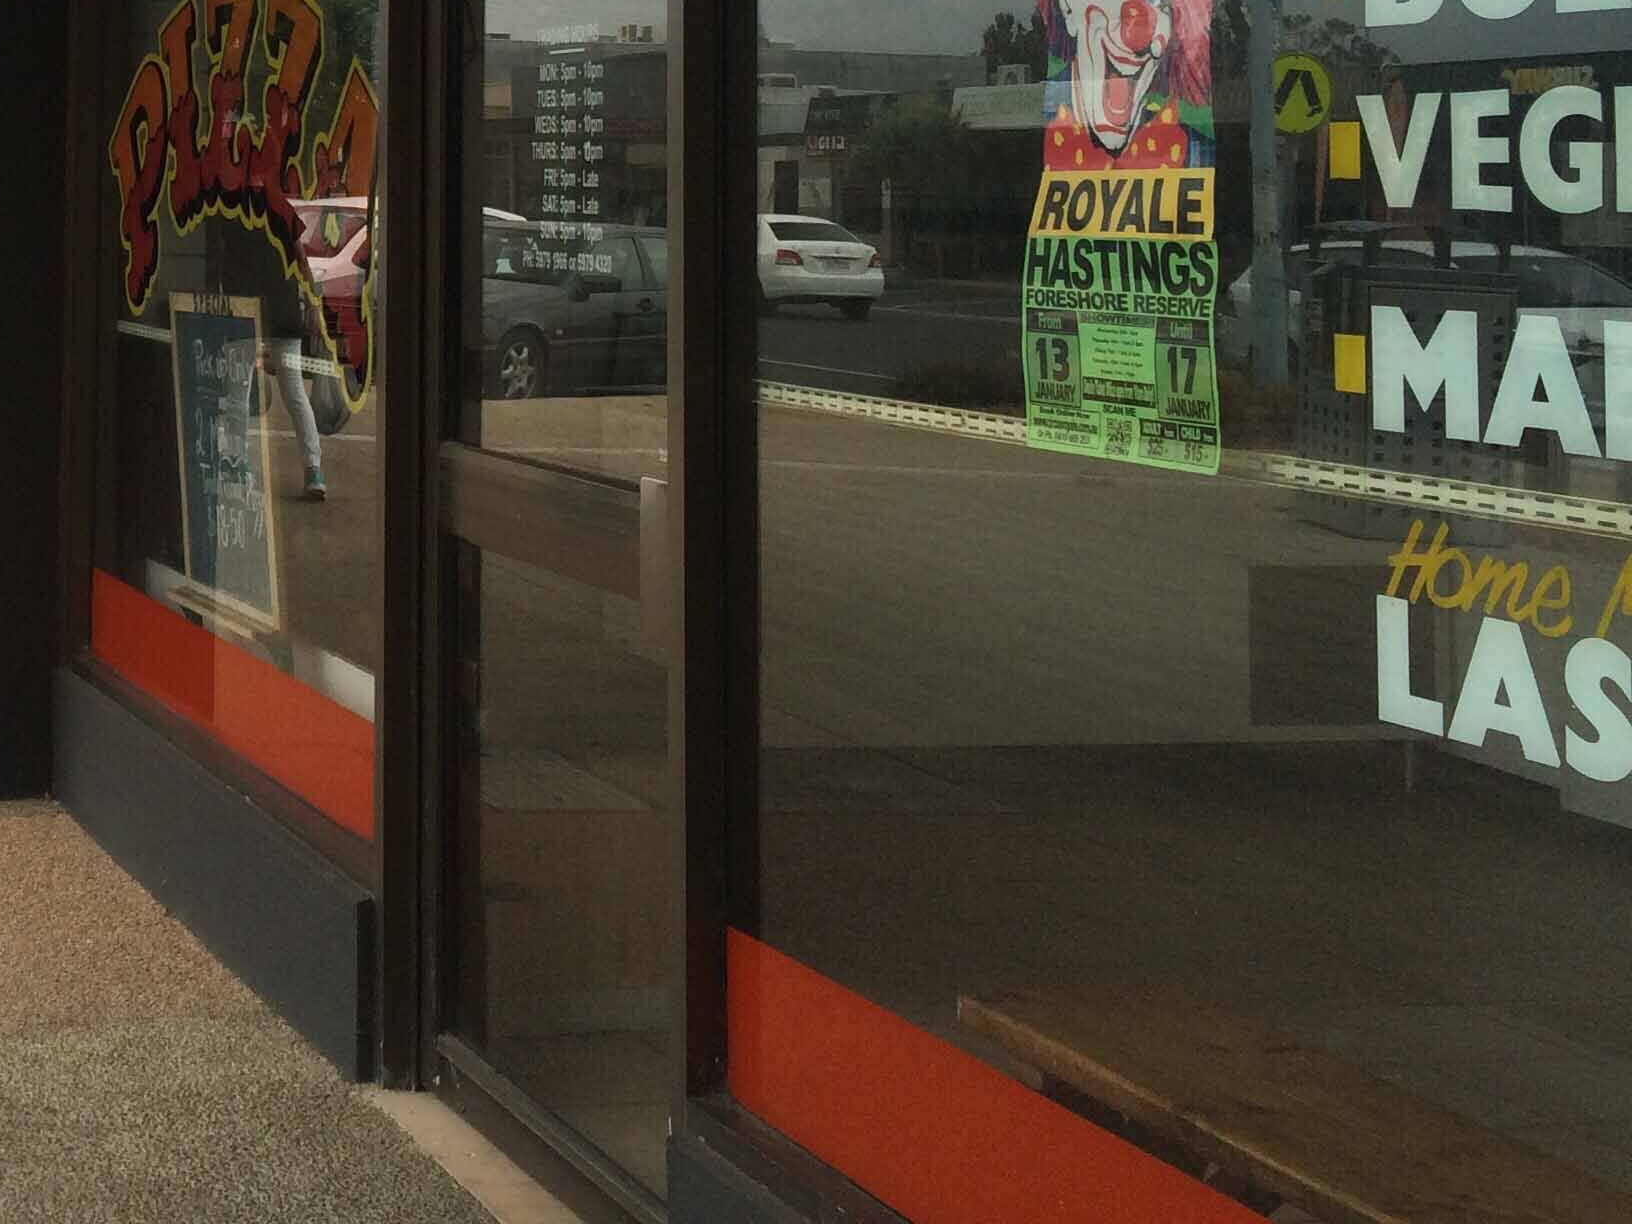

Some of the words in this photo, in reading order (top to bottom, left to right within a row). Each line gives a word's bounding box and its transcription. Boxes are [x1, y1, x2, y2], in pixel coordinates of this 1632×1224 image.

[560, 62, 576, 84] 5pm
[560, 89, 576, 110] 5pm
[560, 142, 576, 164] 5pm
[560, 168, 576, 191] 5pm
[582, 168, 599, 188] Late
[560, 195, 576, 217] 5pm
[582, 195, 599, 215] Late
[1039, 175, 1206, 235] ROYALE
[1026, 237, 1214, 298] HASTINGS
[1026, 288, 1129, 313] FORESHORE
[1134, 294, 1211, 318] RESERVE
[1035, 337, 1070, 382] 13
[1168, 347, 1198, 394] 17
[1035, 381, 1076, 402] JANUARY
[1166, 398, 1212, 423] JANUARY
[1387, 520, 1574, 638] Home
